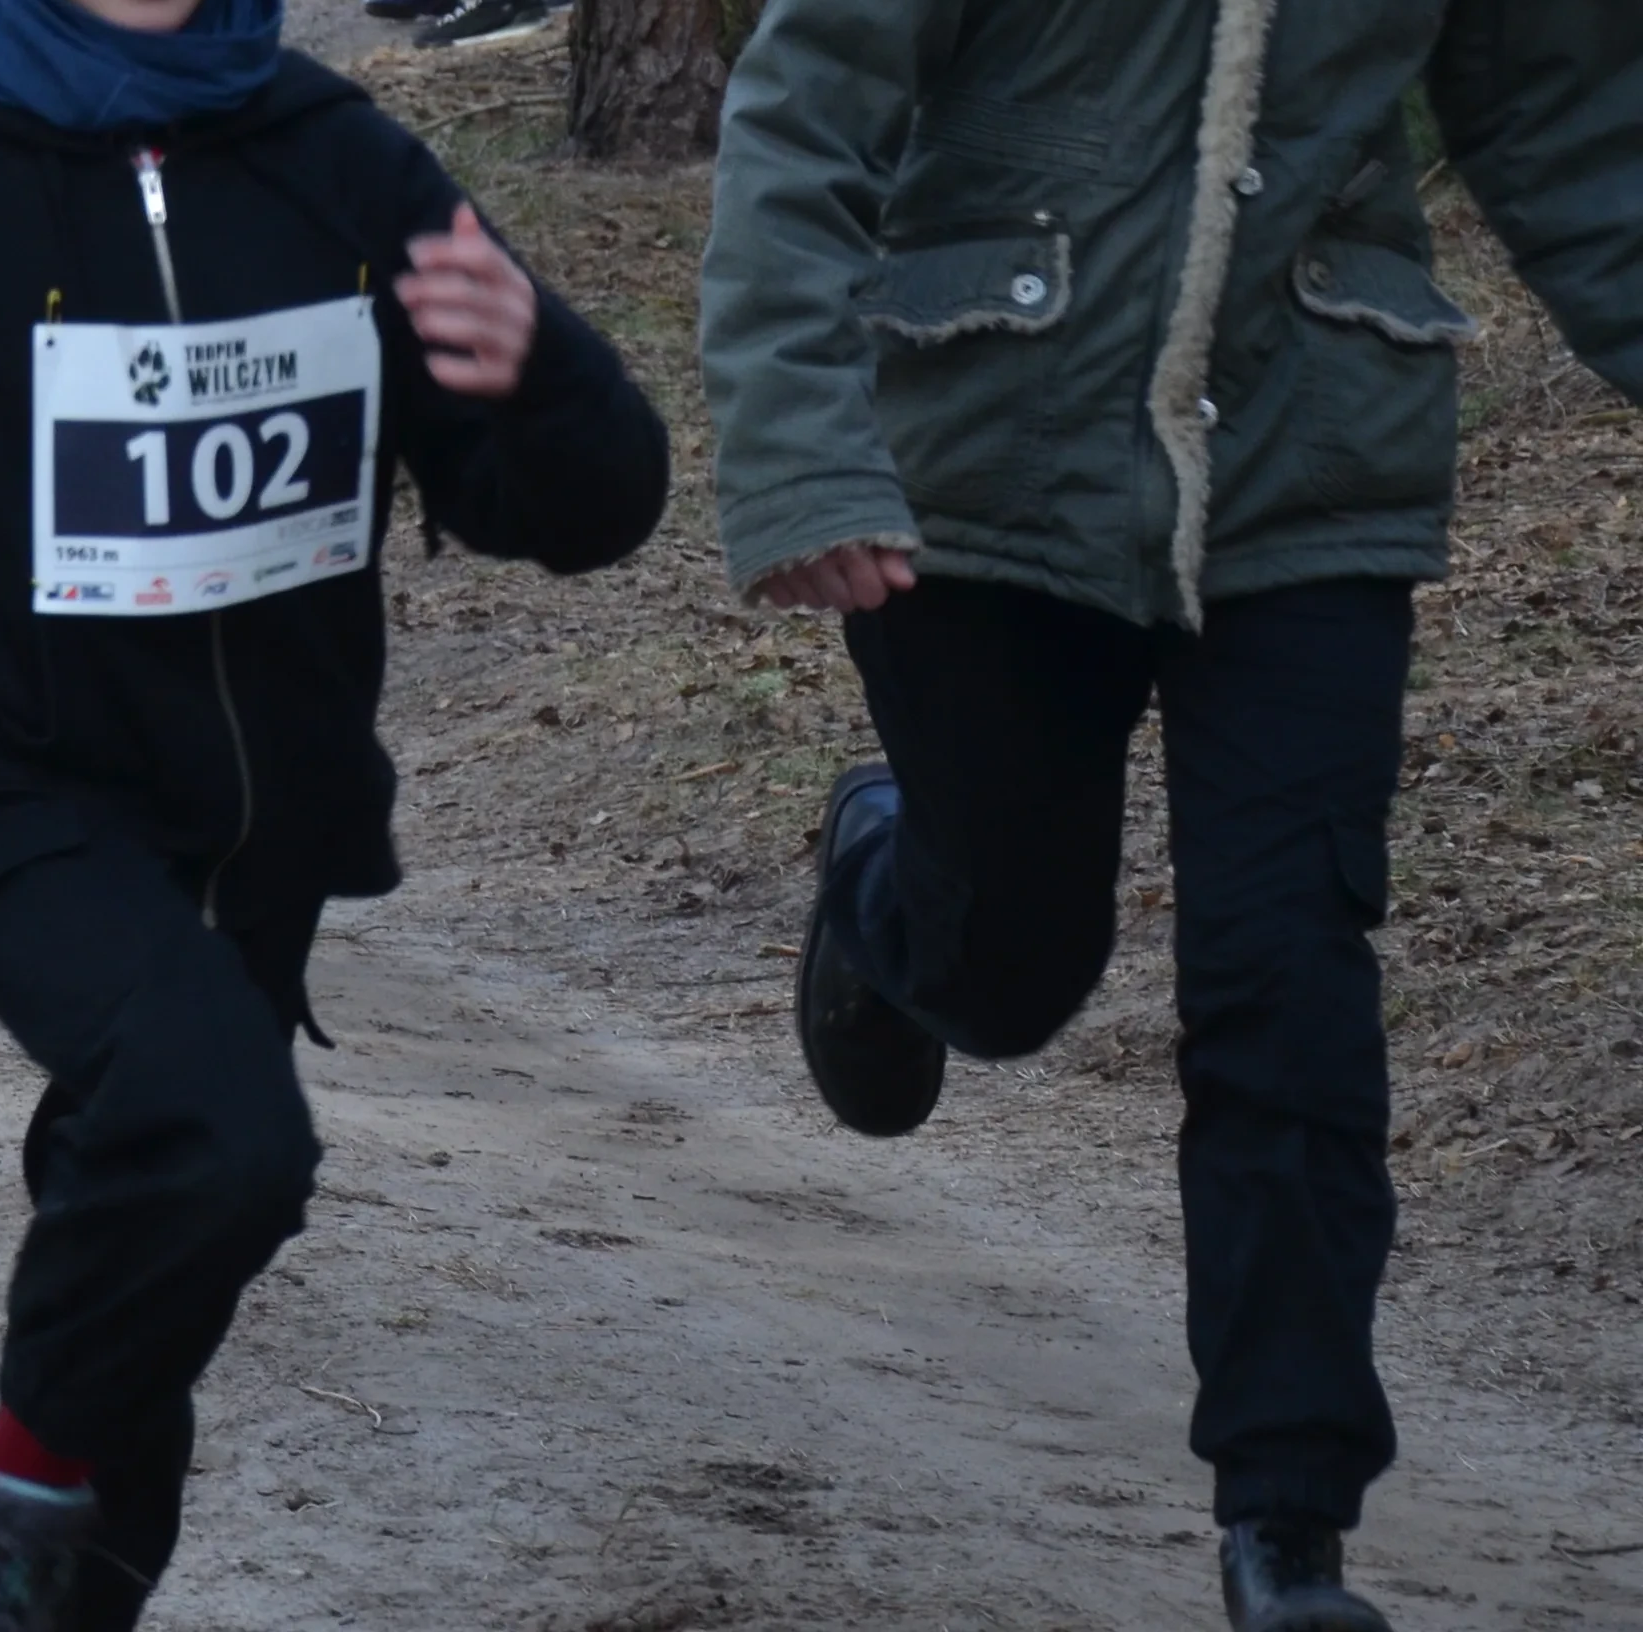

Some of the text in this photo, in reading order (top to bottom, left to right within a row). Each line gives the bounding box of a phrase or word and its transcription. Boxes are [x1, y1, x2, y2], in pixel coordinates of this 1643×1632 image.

[183, 339, 247, 363] TROPEM
[187, 350, 298, 397] WILCZYM
[125, 411, 311, 527] 102
[56, 546, 119, 561] 1963 m
